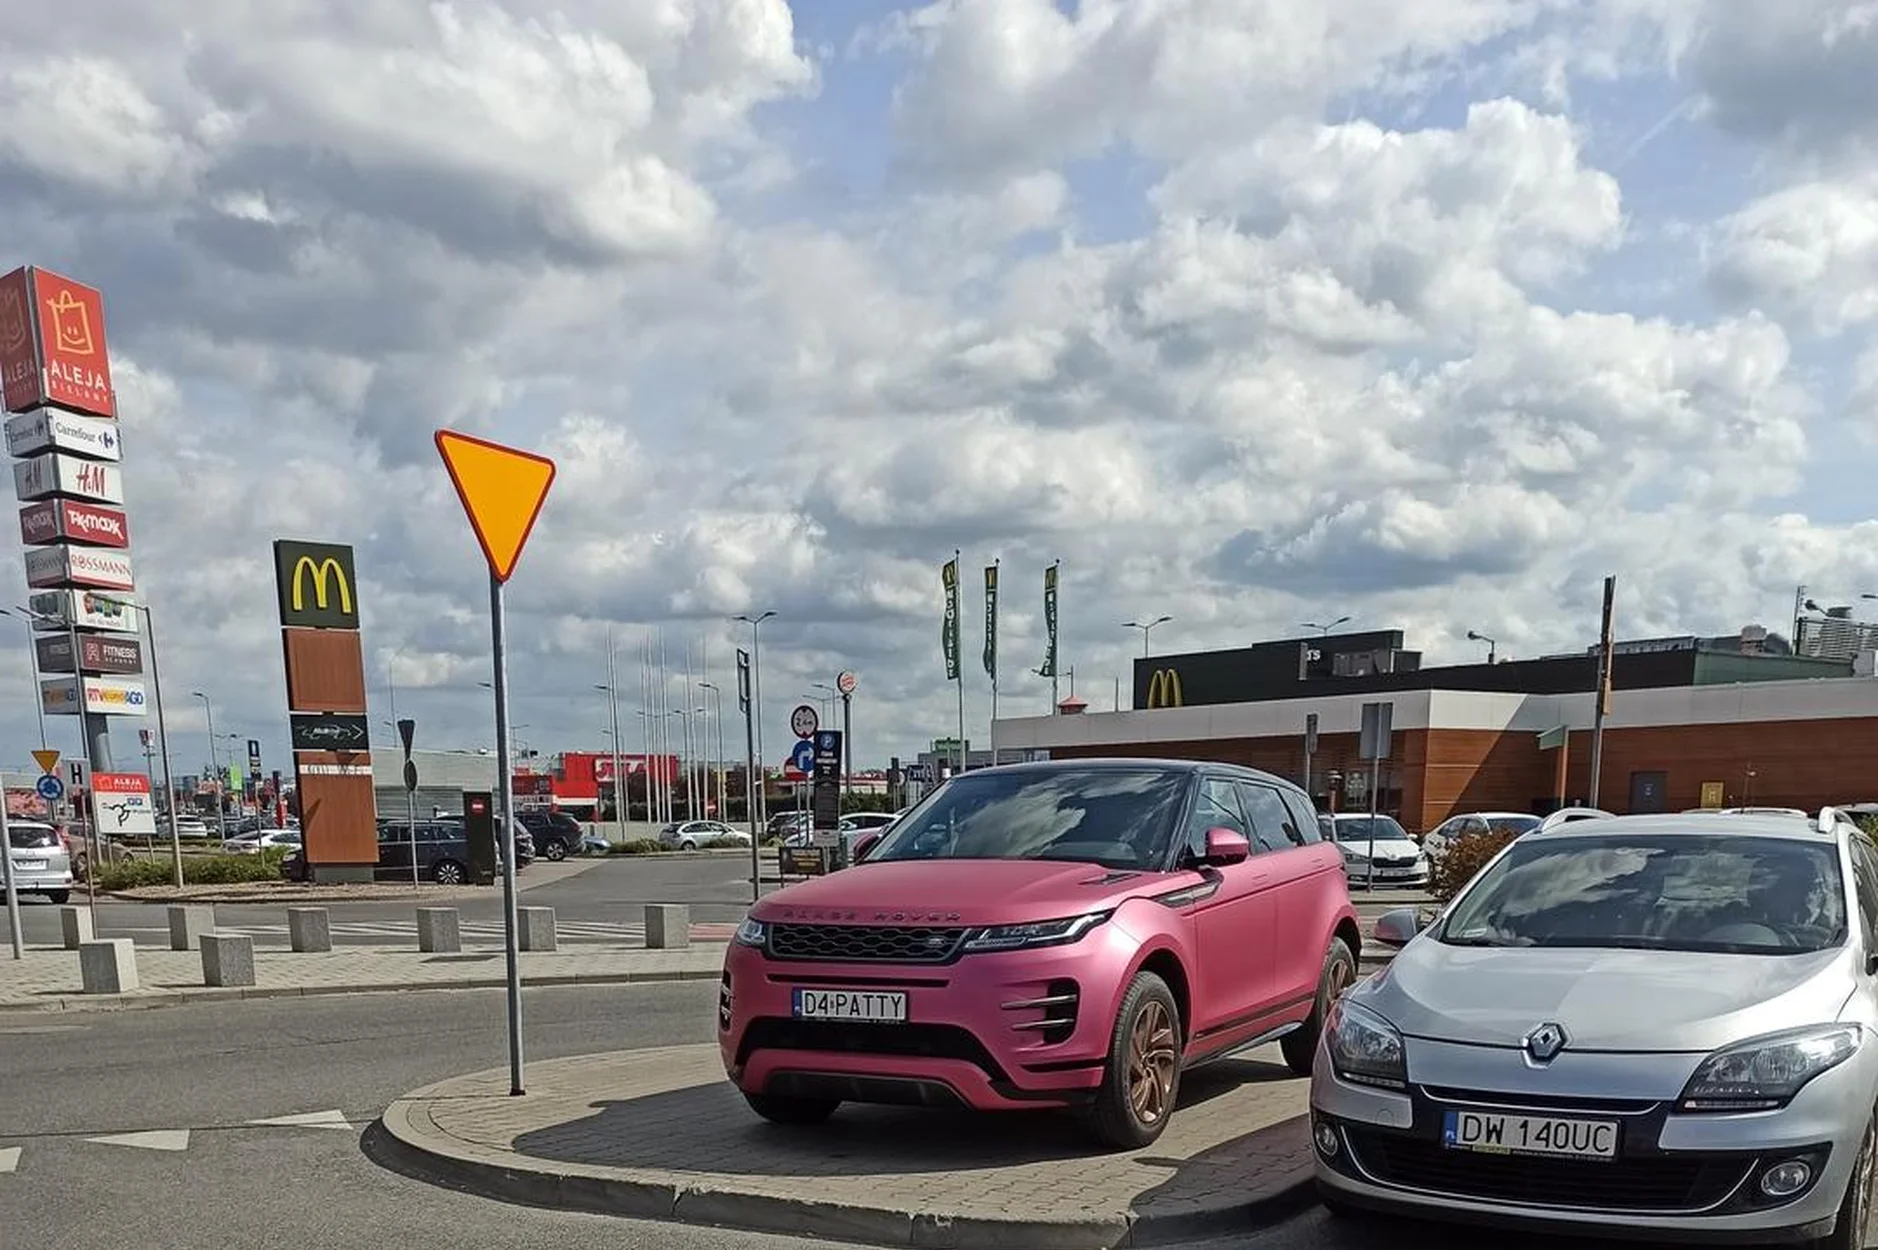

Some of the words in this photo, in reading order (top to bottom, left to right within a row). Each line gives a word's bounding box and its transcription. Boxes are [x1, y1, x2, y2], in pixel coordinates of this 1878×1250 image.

[51, 360, 107, 392] ALEJA
[55, 422, 97, 443] Carrefour
[76, 463, 105, 497] H&M
[71, 553, 131, 576] ROSSMANN
[103, 645, 137, 659] FITNESS
[874, 911, 961, 921] ROVER
[835, 994, 903, 1018] PATTY
[1462, 1115, 1505, 1145] DW
[1519, 1119, 1612, 1153] 140UC
